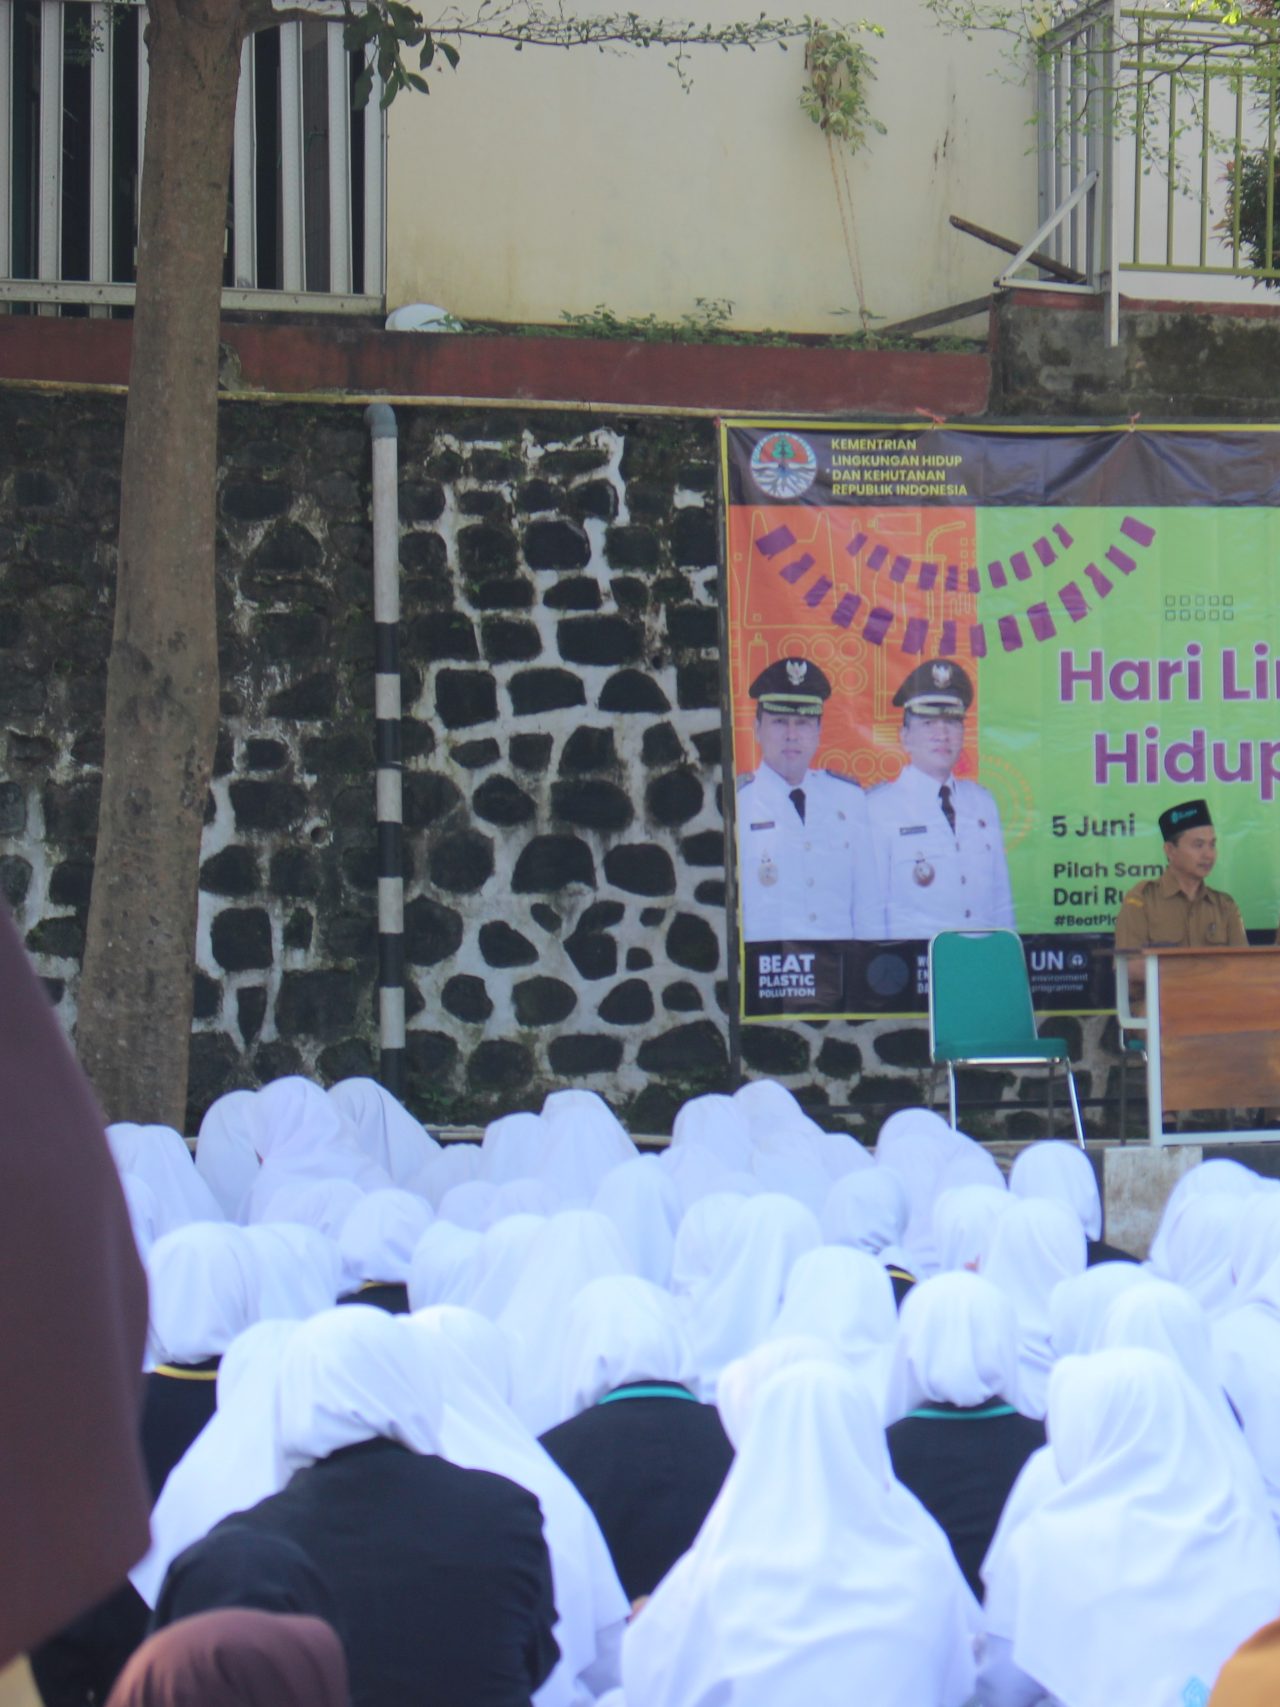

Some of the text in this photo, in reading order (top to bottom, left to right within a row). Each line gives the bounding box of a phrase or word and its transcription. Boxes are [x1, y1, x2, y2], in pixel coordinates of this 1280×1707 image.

[831, 438, 917, 450] KEMENTRIAN
[831, 455, 962, 467] LINGKUNGAN HIDUP
[832, 469, 946, 481] DAN KEHUTANAN
[832, 484, 968, 496] REPUBLIK INDONESIA
[1059, 643, 1202, 702] Hari
[1052, 813, 1135, 838] 5 Juni
[1053, 861, 1168, 879] Pilah Sam
[1053, 885, 1098, 906] Dari
[758, 953, 815, 974] BEAT
[1031, 950, 1064, 971] UN
[758, 974, 815, 988] PLASTIC
[758, 987, 816, 999] POLLUTION
